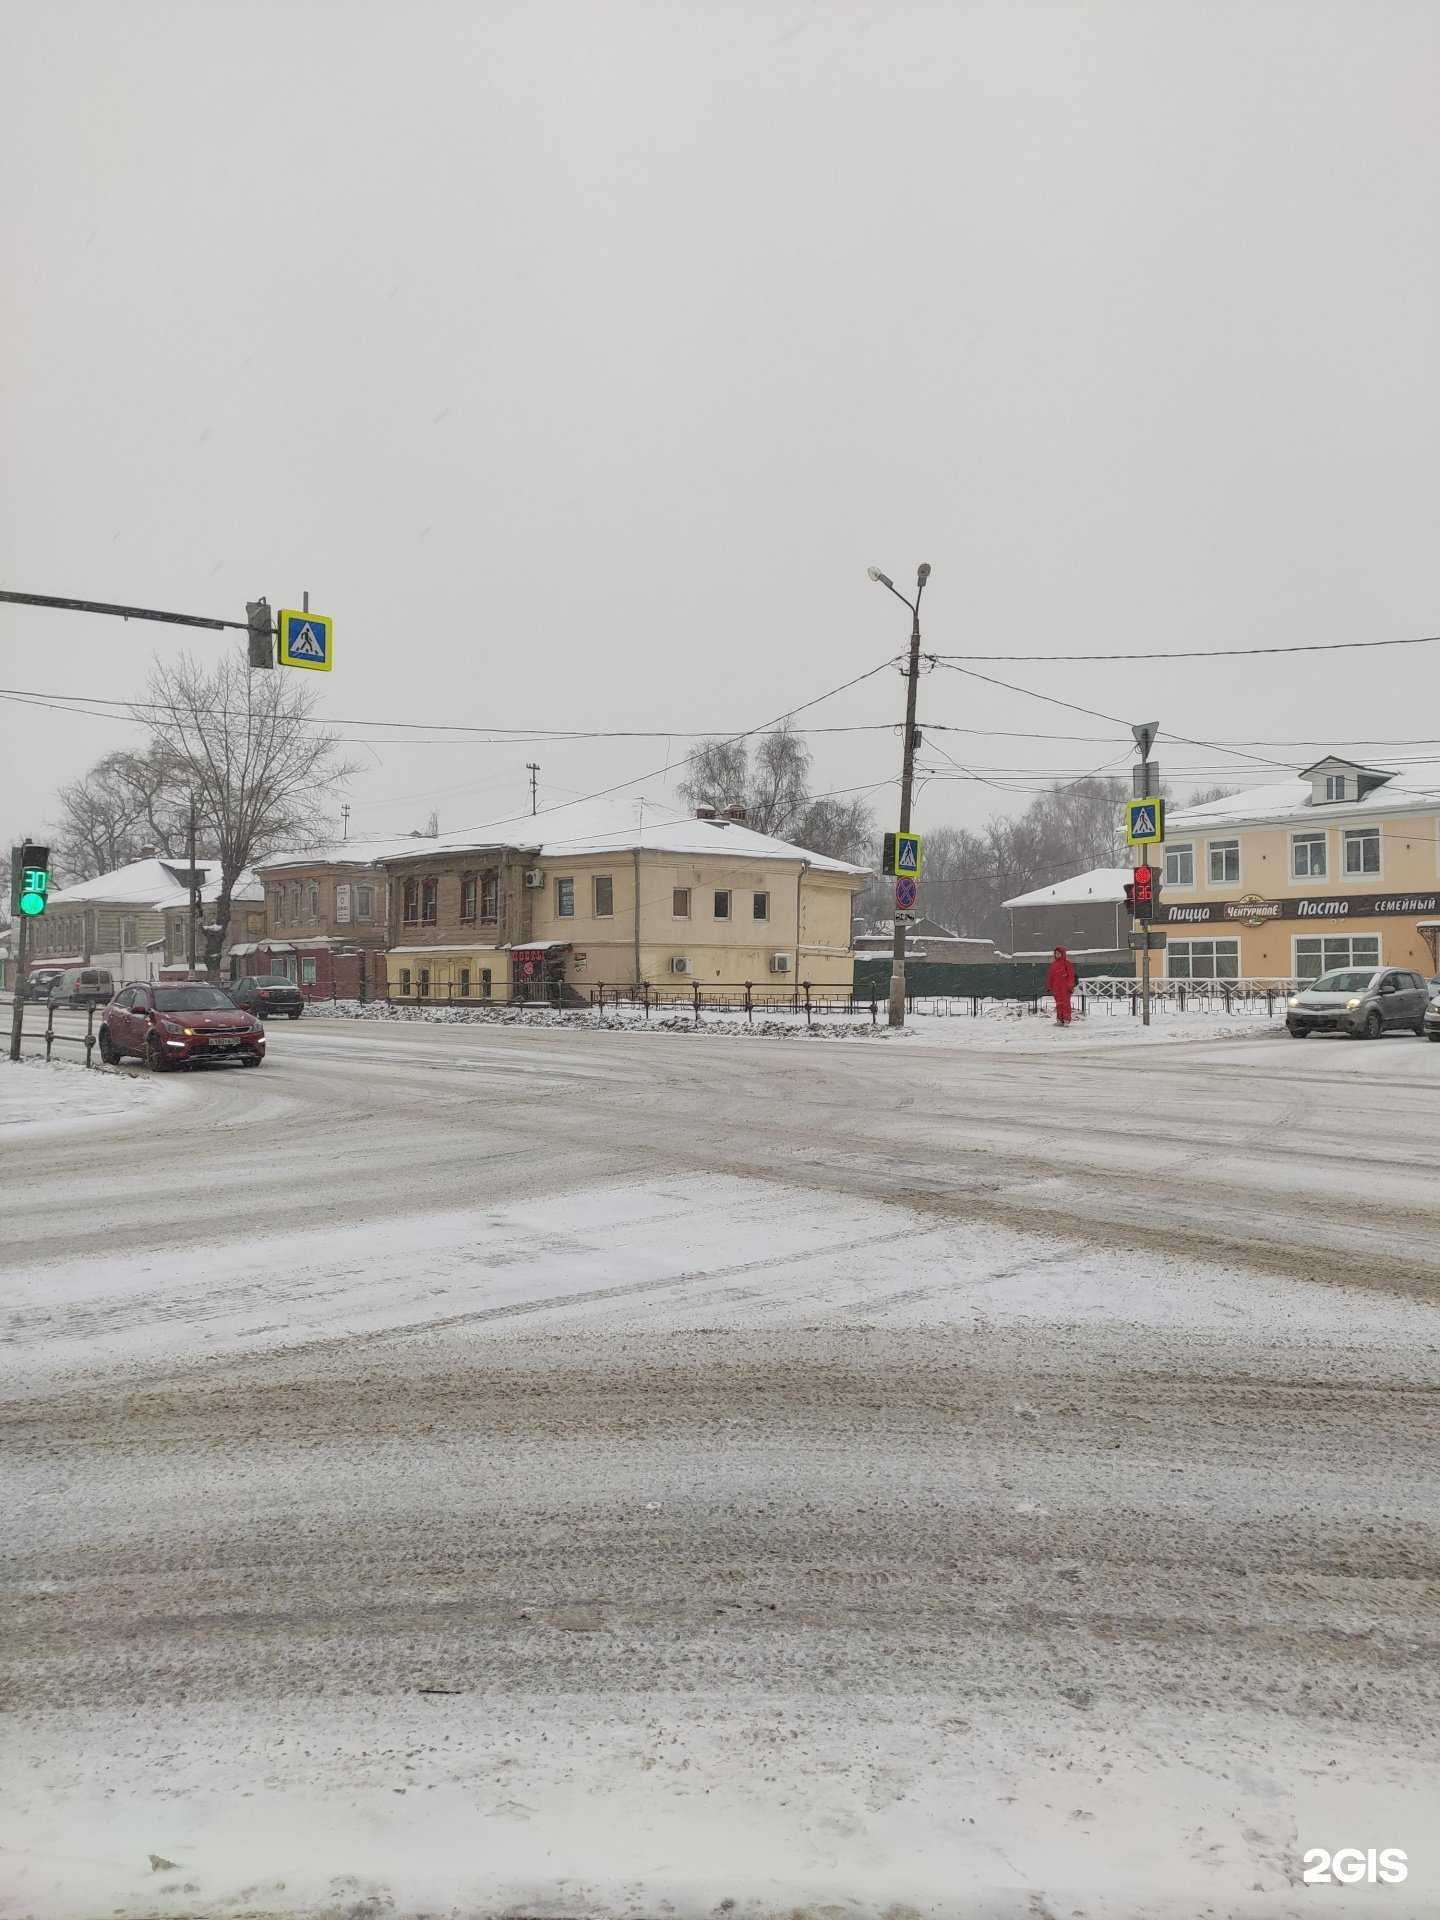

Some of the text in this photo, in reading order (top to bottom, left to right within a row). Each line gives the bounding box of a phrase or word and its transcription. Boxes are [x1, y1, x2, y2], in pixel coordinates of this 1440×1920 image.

[25, 871, 46, 891] 30
[1297, 900, 1349, 916] Паста
[1374, 897, 1437, 912] СЕМЕЙНЫЙ
[1168, 906, 1211, 922] Пицца
